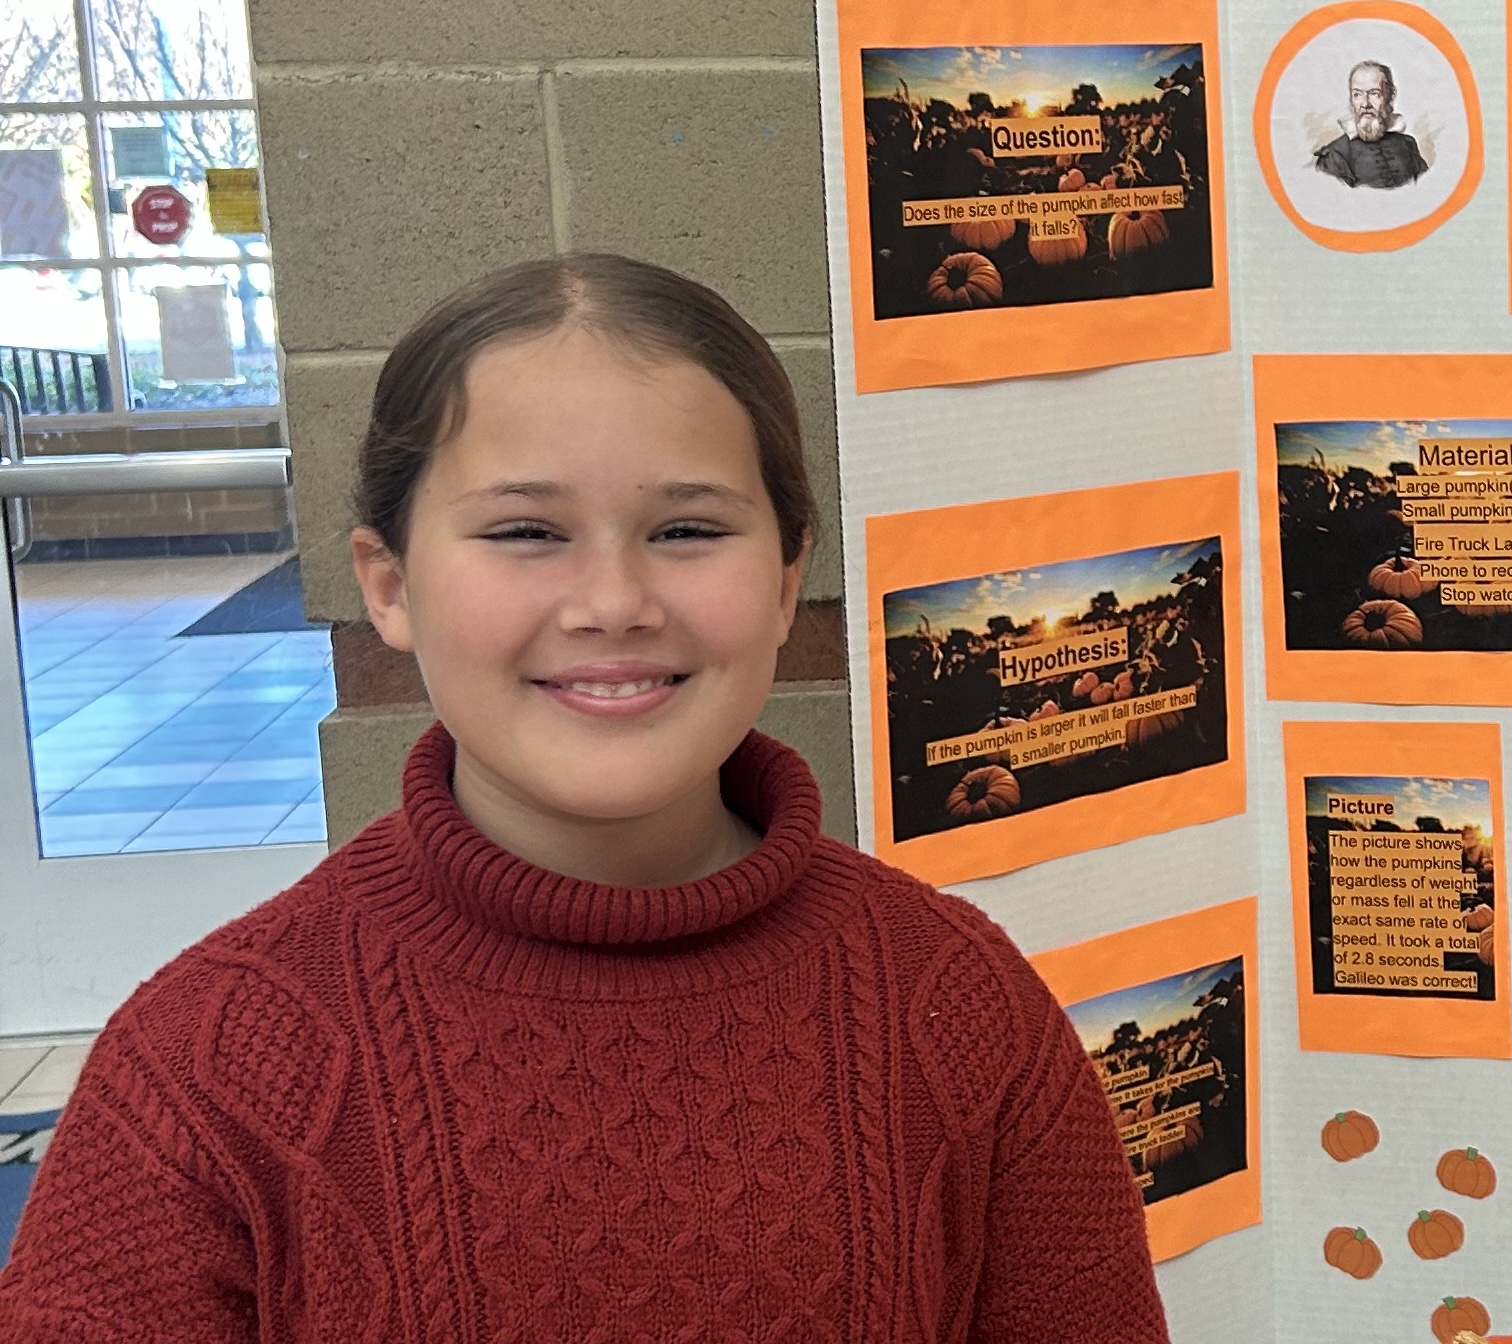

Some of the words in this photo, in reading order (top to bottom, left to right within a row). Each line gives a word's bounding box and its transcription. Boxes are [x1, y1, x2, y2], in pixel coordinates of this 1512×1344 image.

[994, 125, 1100, 150] Question:
[904, 205, 940, 221] Does
[944, 203, 964, 218] the
[969, 201, 996, 216] size
[1001, 198, 1014, 214] of
[1018, 198, 1037, 214] the
[1043, 194, 1097, 216] pumpkin
[1101, 192, 1131, 210] affect
[1134, 191, 1158, 207] how
[1163, 190, 1182, 205] fast
[1031, 221, 1039, 236] it
[1043, 219, 1077, 236] falls?
[1397, 479, 1440, 496] Large
[1403, 504, 1445, 517] Small
[1416, 537, 1444, 551] Fire
[1448, 537, 1489, 551] Truck
[1420, 564, 1468, 577] Phone
[1473, 565, 1486, 577] to
[1442, 588, 1475, 603] Stop
[1001, 638, 1127, 682] Hypothesis:
[940, 743, 961, 758] the
[966, 732, 1022, 754] pumpkin
[1027, 729, 1037, 739] is
[1041, 720, 1074, 737] larger
[1079, 715, 1086, 726] it
[1090, 709, 1109, 724] will
[1112, 705, 1129, 719] fall
[1133, 698, 1166, 715] faster
[1170, 692, 1195, 706] than
[1011, 755, 1019, 764] a
[1023, 742, 1065, 762] smaller
[1070, 728, 1125, 751] pumpkin.
[1329, 798, 1394, 814] Picture
[1330, 834, 1357, 847] The
[1362, 835, 1410, 851] picture
[1416, 837, 1462, 849] shows
[1331, 854, 1360, 867] how
[1365, 856, 1387, 868] the
[1392, 857, 1462, 871] pumpkins
[1332, 875, 1406, 889] regardless
[1412, 876, 1425, 888] of
[1429, 877, 1477, 892] weight
[1332, 895, 1346, 905] or
[1351, 895, 1389, 907] mass
[1394, 895, 1414, 908] fell
[1420, 897, 1433, 908] at
[1438, 897, 1459, 908] the
[1333, 915, 1372, 926] exact
[1376, 917, 1415, 927] same
[1420, 917, 1448, 928] rate
[1453, 917, 1466, 929] of
[1387, 934, 1395, 946] It
[1400, 933, 1430, 948] took
[1435, 938, 1443, 948] a
[1449, 935, 1479, 948] total
[1334, 953, 1348, 964] of
[1352, 954, 1373, 965] 2.8
[1335, 970, 1385, 985] Galileo
[1389, 975, 1418, 986] was
[1423, 975, 1476, 989] correct!
